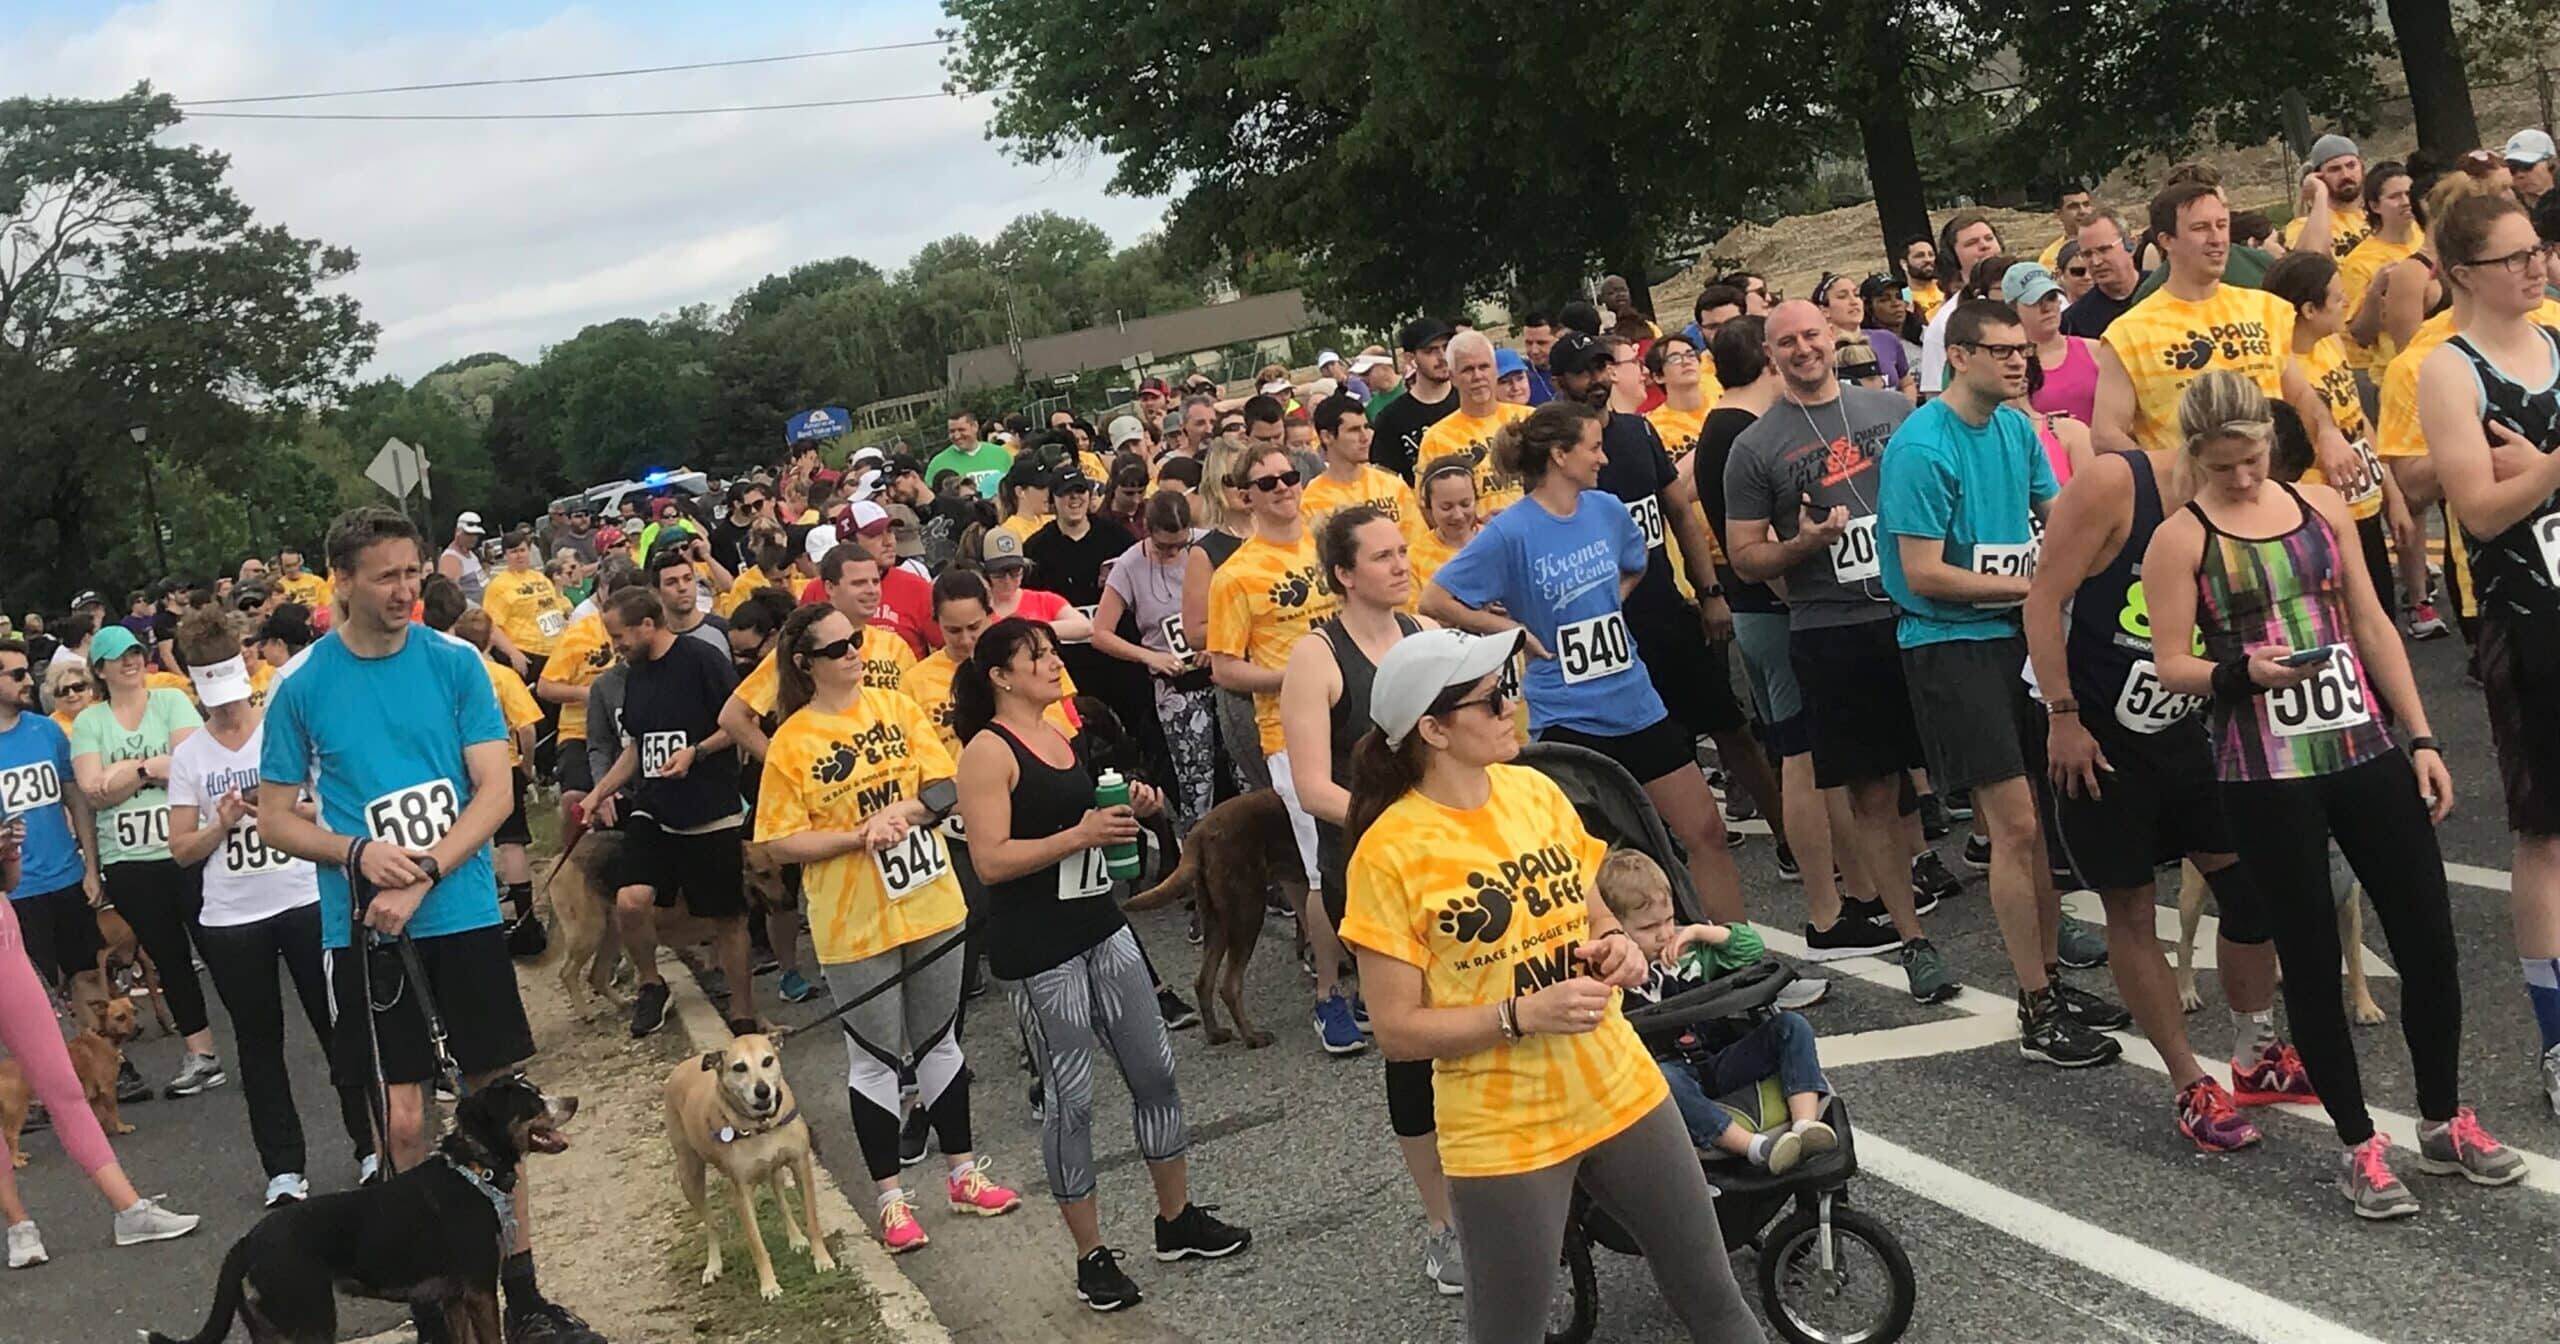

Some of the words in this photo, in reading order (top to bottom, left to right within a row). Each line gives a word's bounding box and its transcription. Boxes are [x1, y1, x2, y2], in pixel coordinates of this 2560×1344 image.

[2210, 321, 2270, 343] PAWS
[2222, 341, 2240, 360] &
[2240, 340, 2272, 356] FEET
[1535, 538, 1610, 585] Kremer
[1543, 578, 1574, 603] Eye
[1560, 616, 1629, 676] 540
[876, 676, 900, 691] FEE
[2272, 649, 2365, 726] 569
[852, 719, 908, 750] PAW
[865, 747, 883, 765] &
[3, 764, 59, 808] 230
[117, 807, 170, 848] 570
[370, 784, 457, 849] 583
[879, 826, 946, 891] 542
[1522, 885, 1552, 918] &
[1473, 948, 1508, 969] RACE
[1521, 925, 1564, 950] DOGGIE
